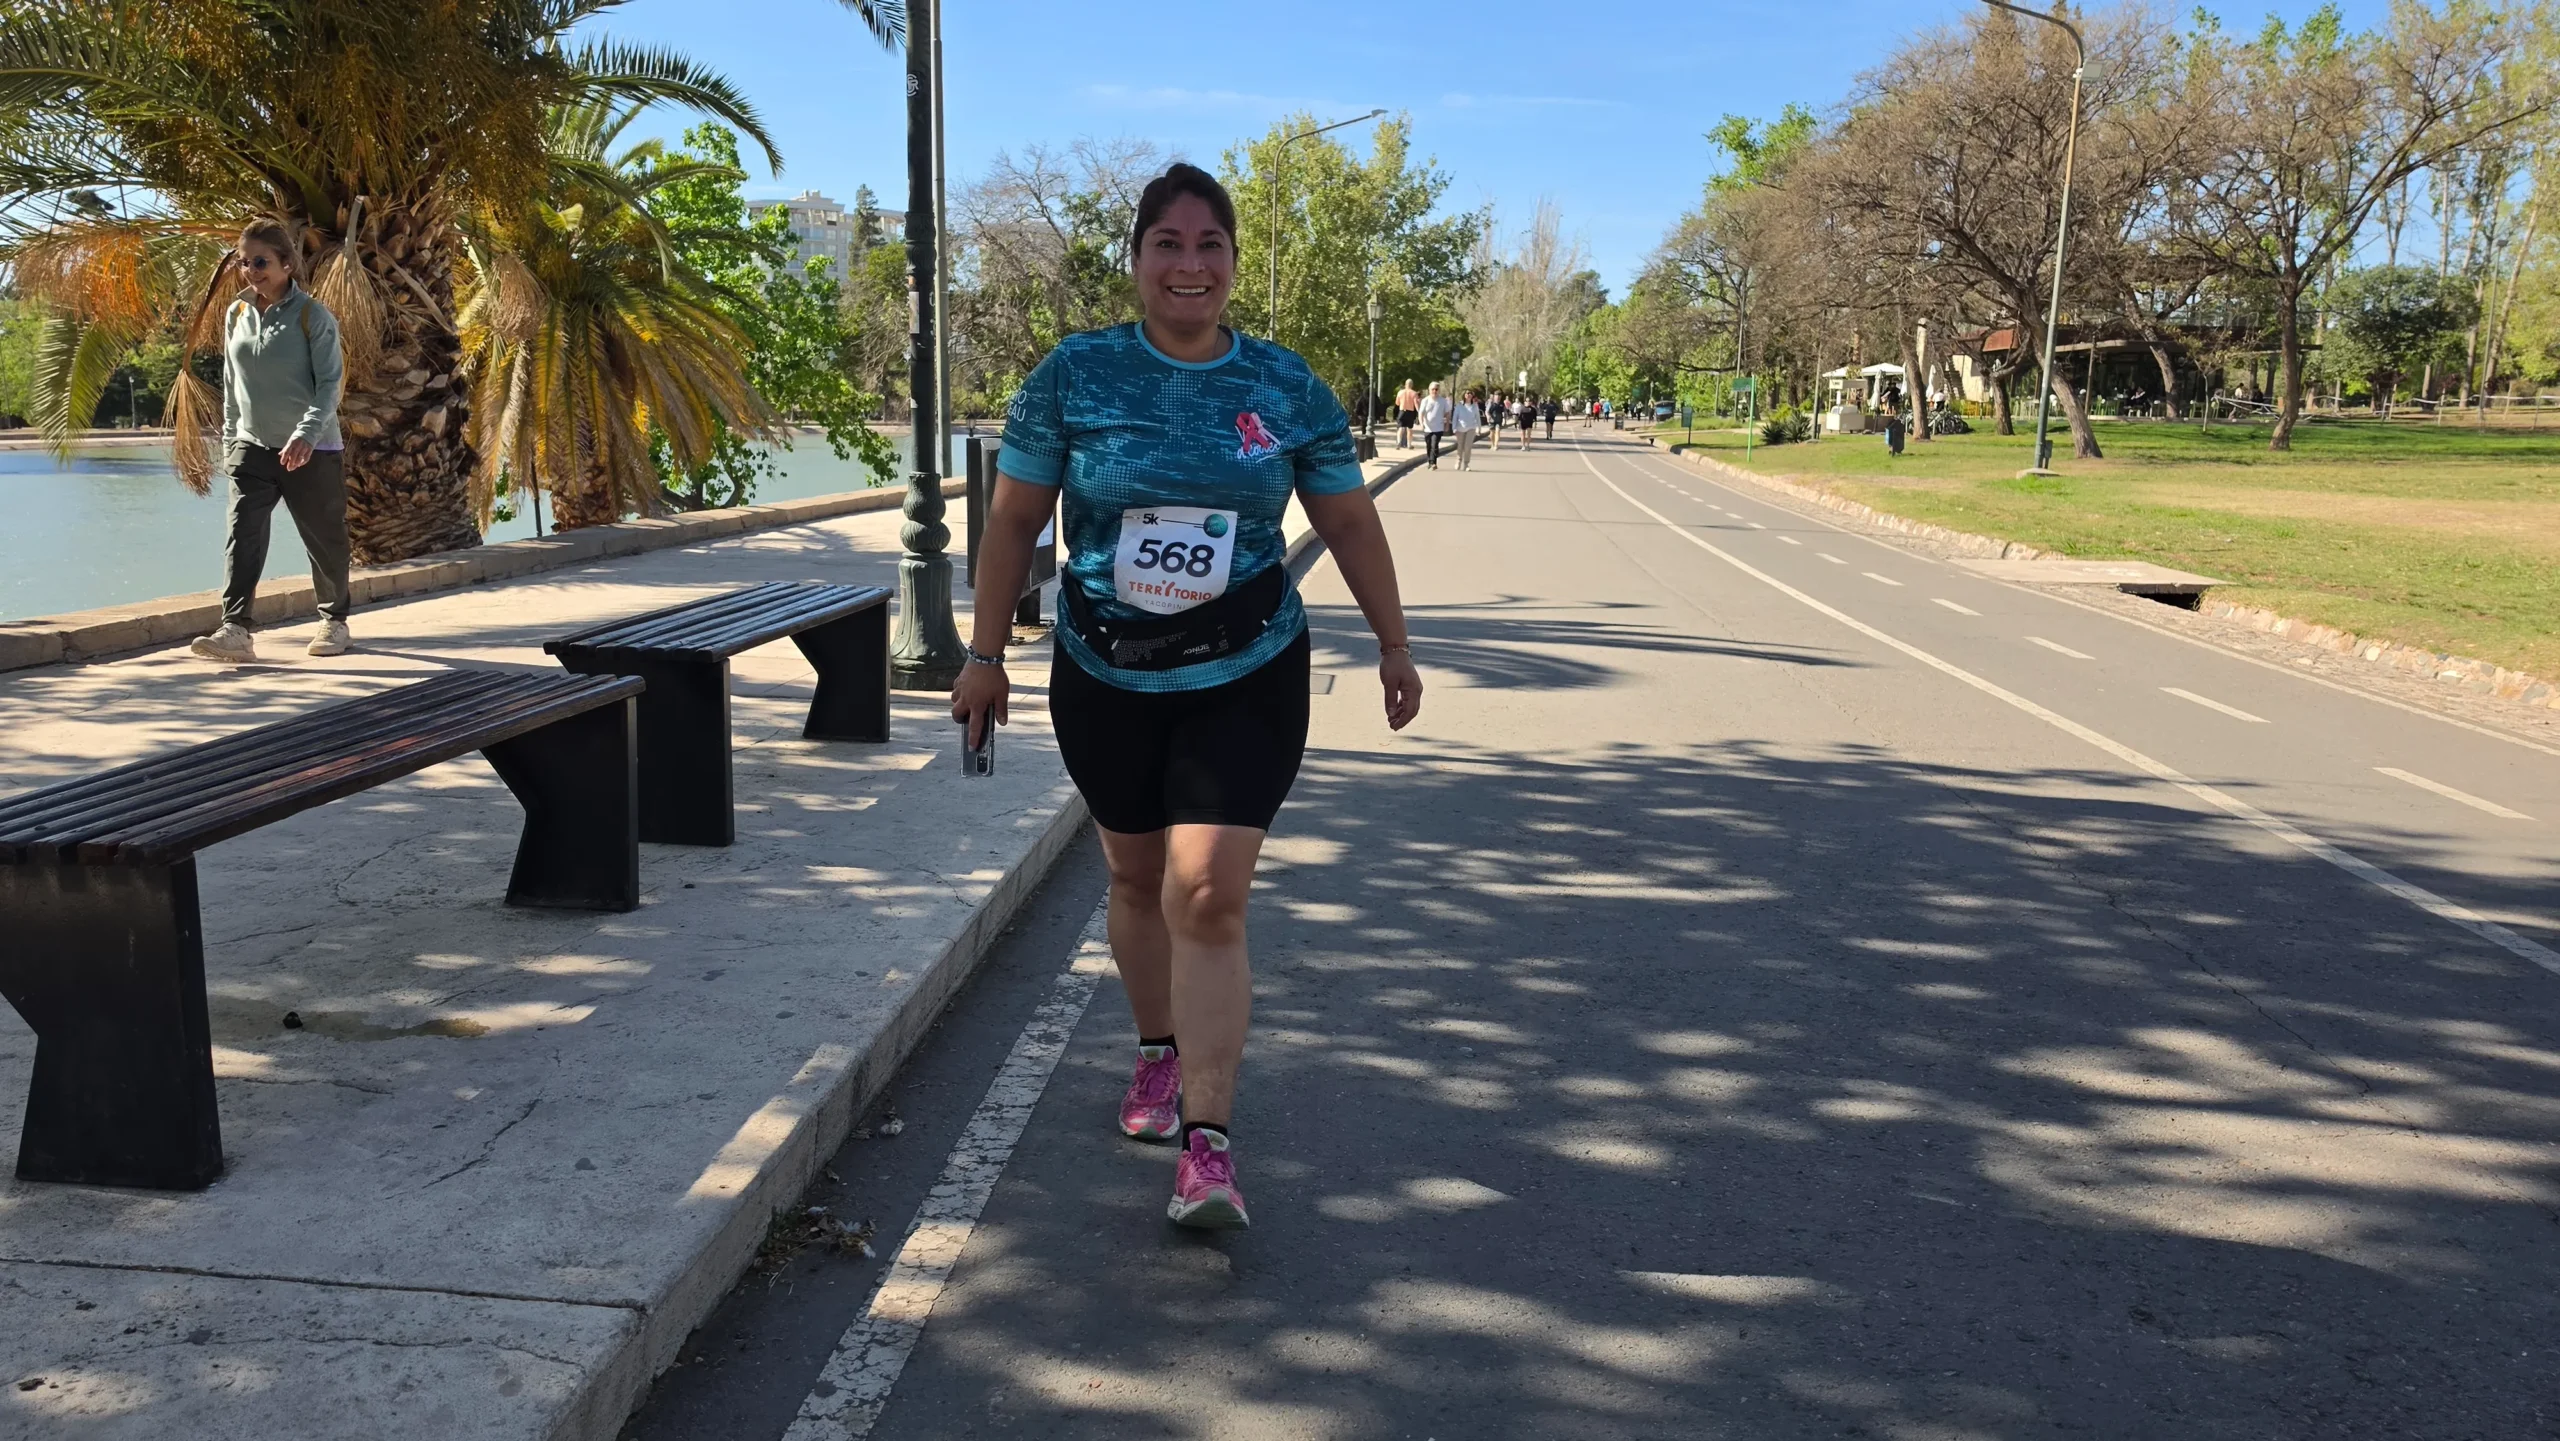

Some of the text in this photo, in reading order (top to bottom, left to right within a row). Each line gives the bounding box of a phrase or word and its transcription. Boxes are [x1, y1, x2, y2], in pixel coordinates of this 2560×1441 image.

[1142, 513, 1159, 526] 5k
[1133, 538, 1215, 577] 568
[1145, 600, 1186, 610] YACOPINI
